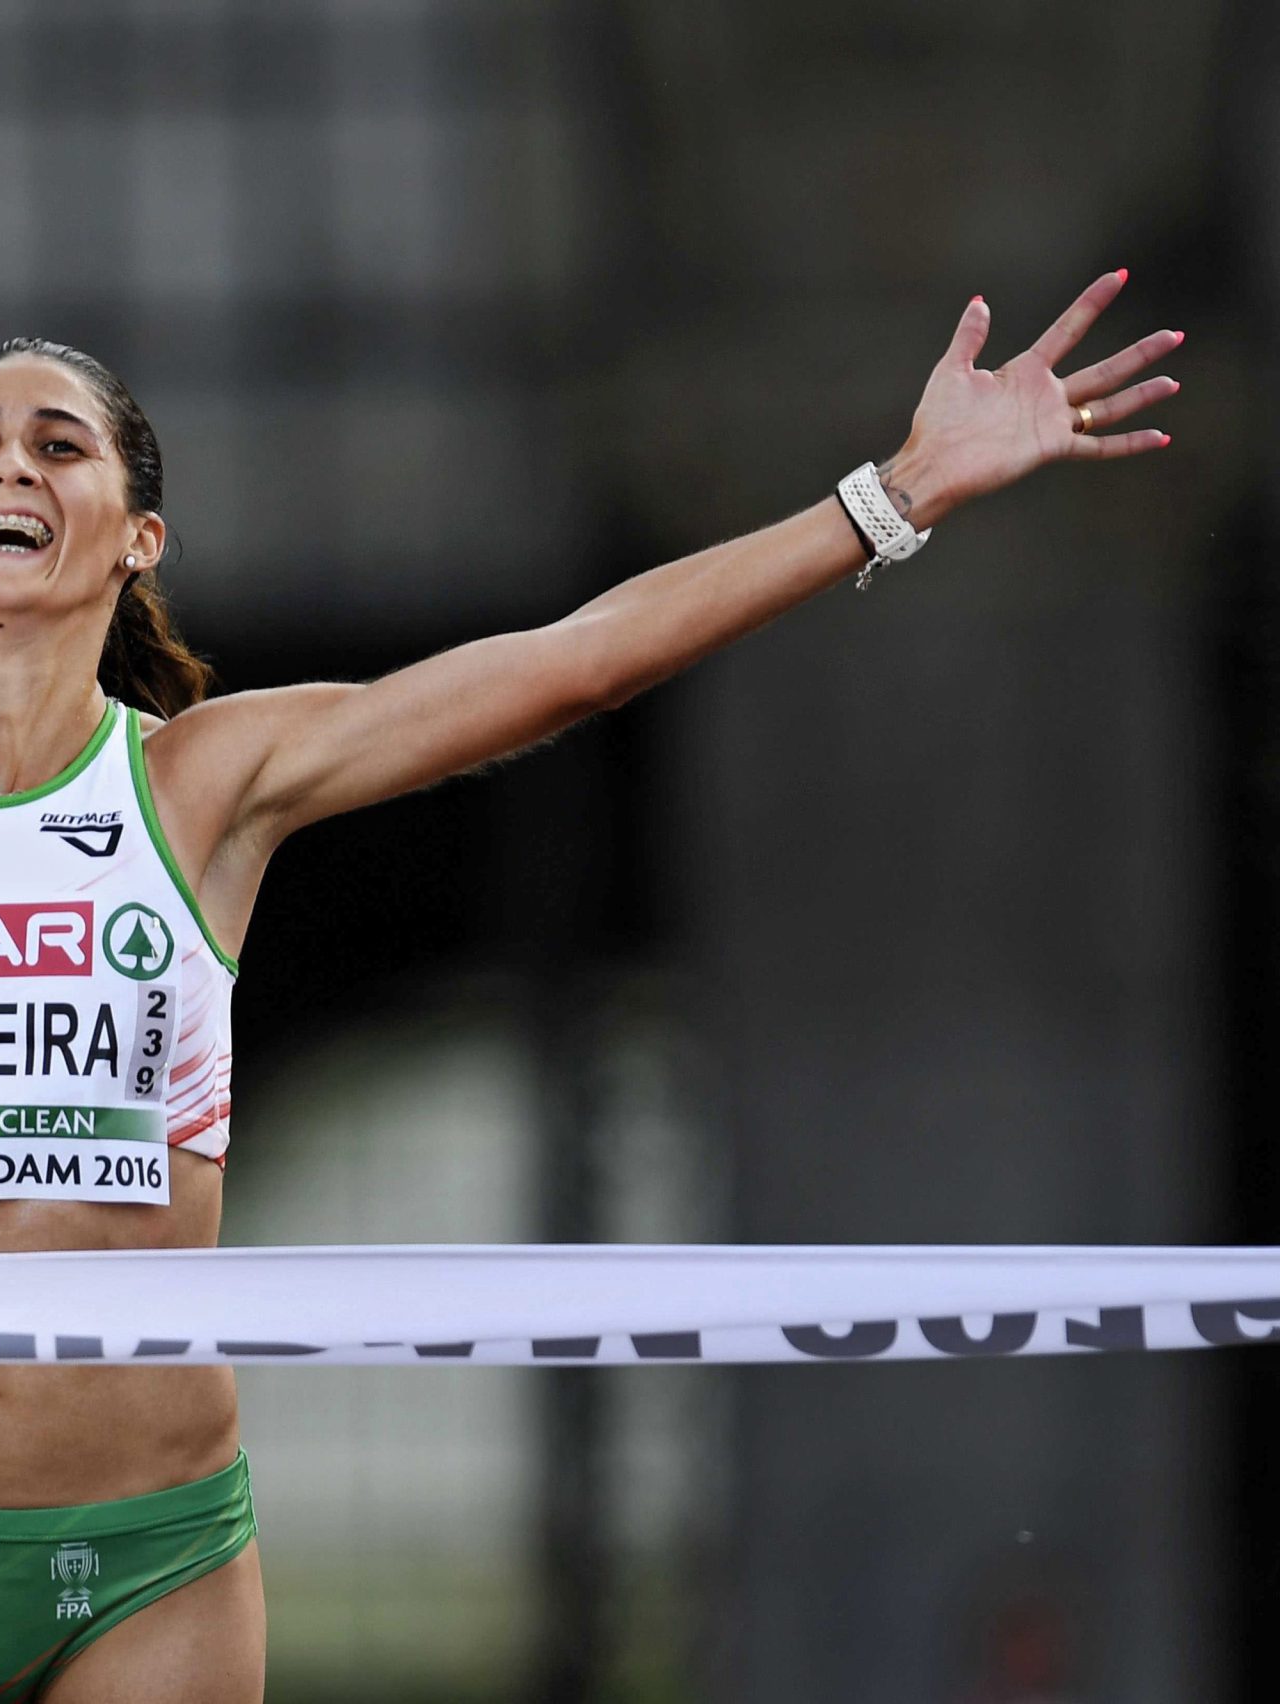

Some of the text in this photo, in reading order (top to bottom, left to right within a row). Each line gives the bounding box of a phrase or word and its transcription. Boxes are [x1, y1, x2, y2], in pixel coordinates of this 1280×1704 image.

[40, 810, 122, 824] OUTPACE
[94, 1155, 162, 1189] 2016
[56, 1601, 93, 1620] FPA
